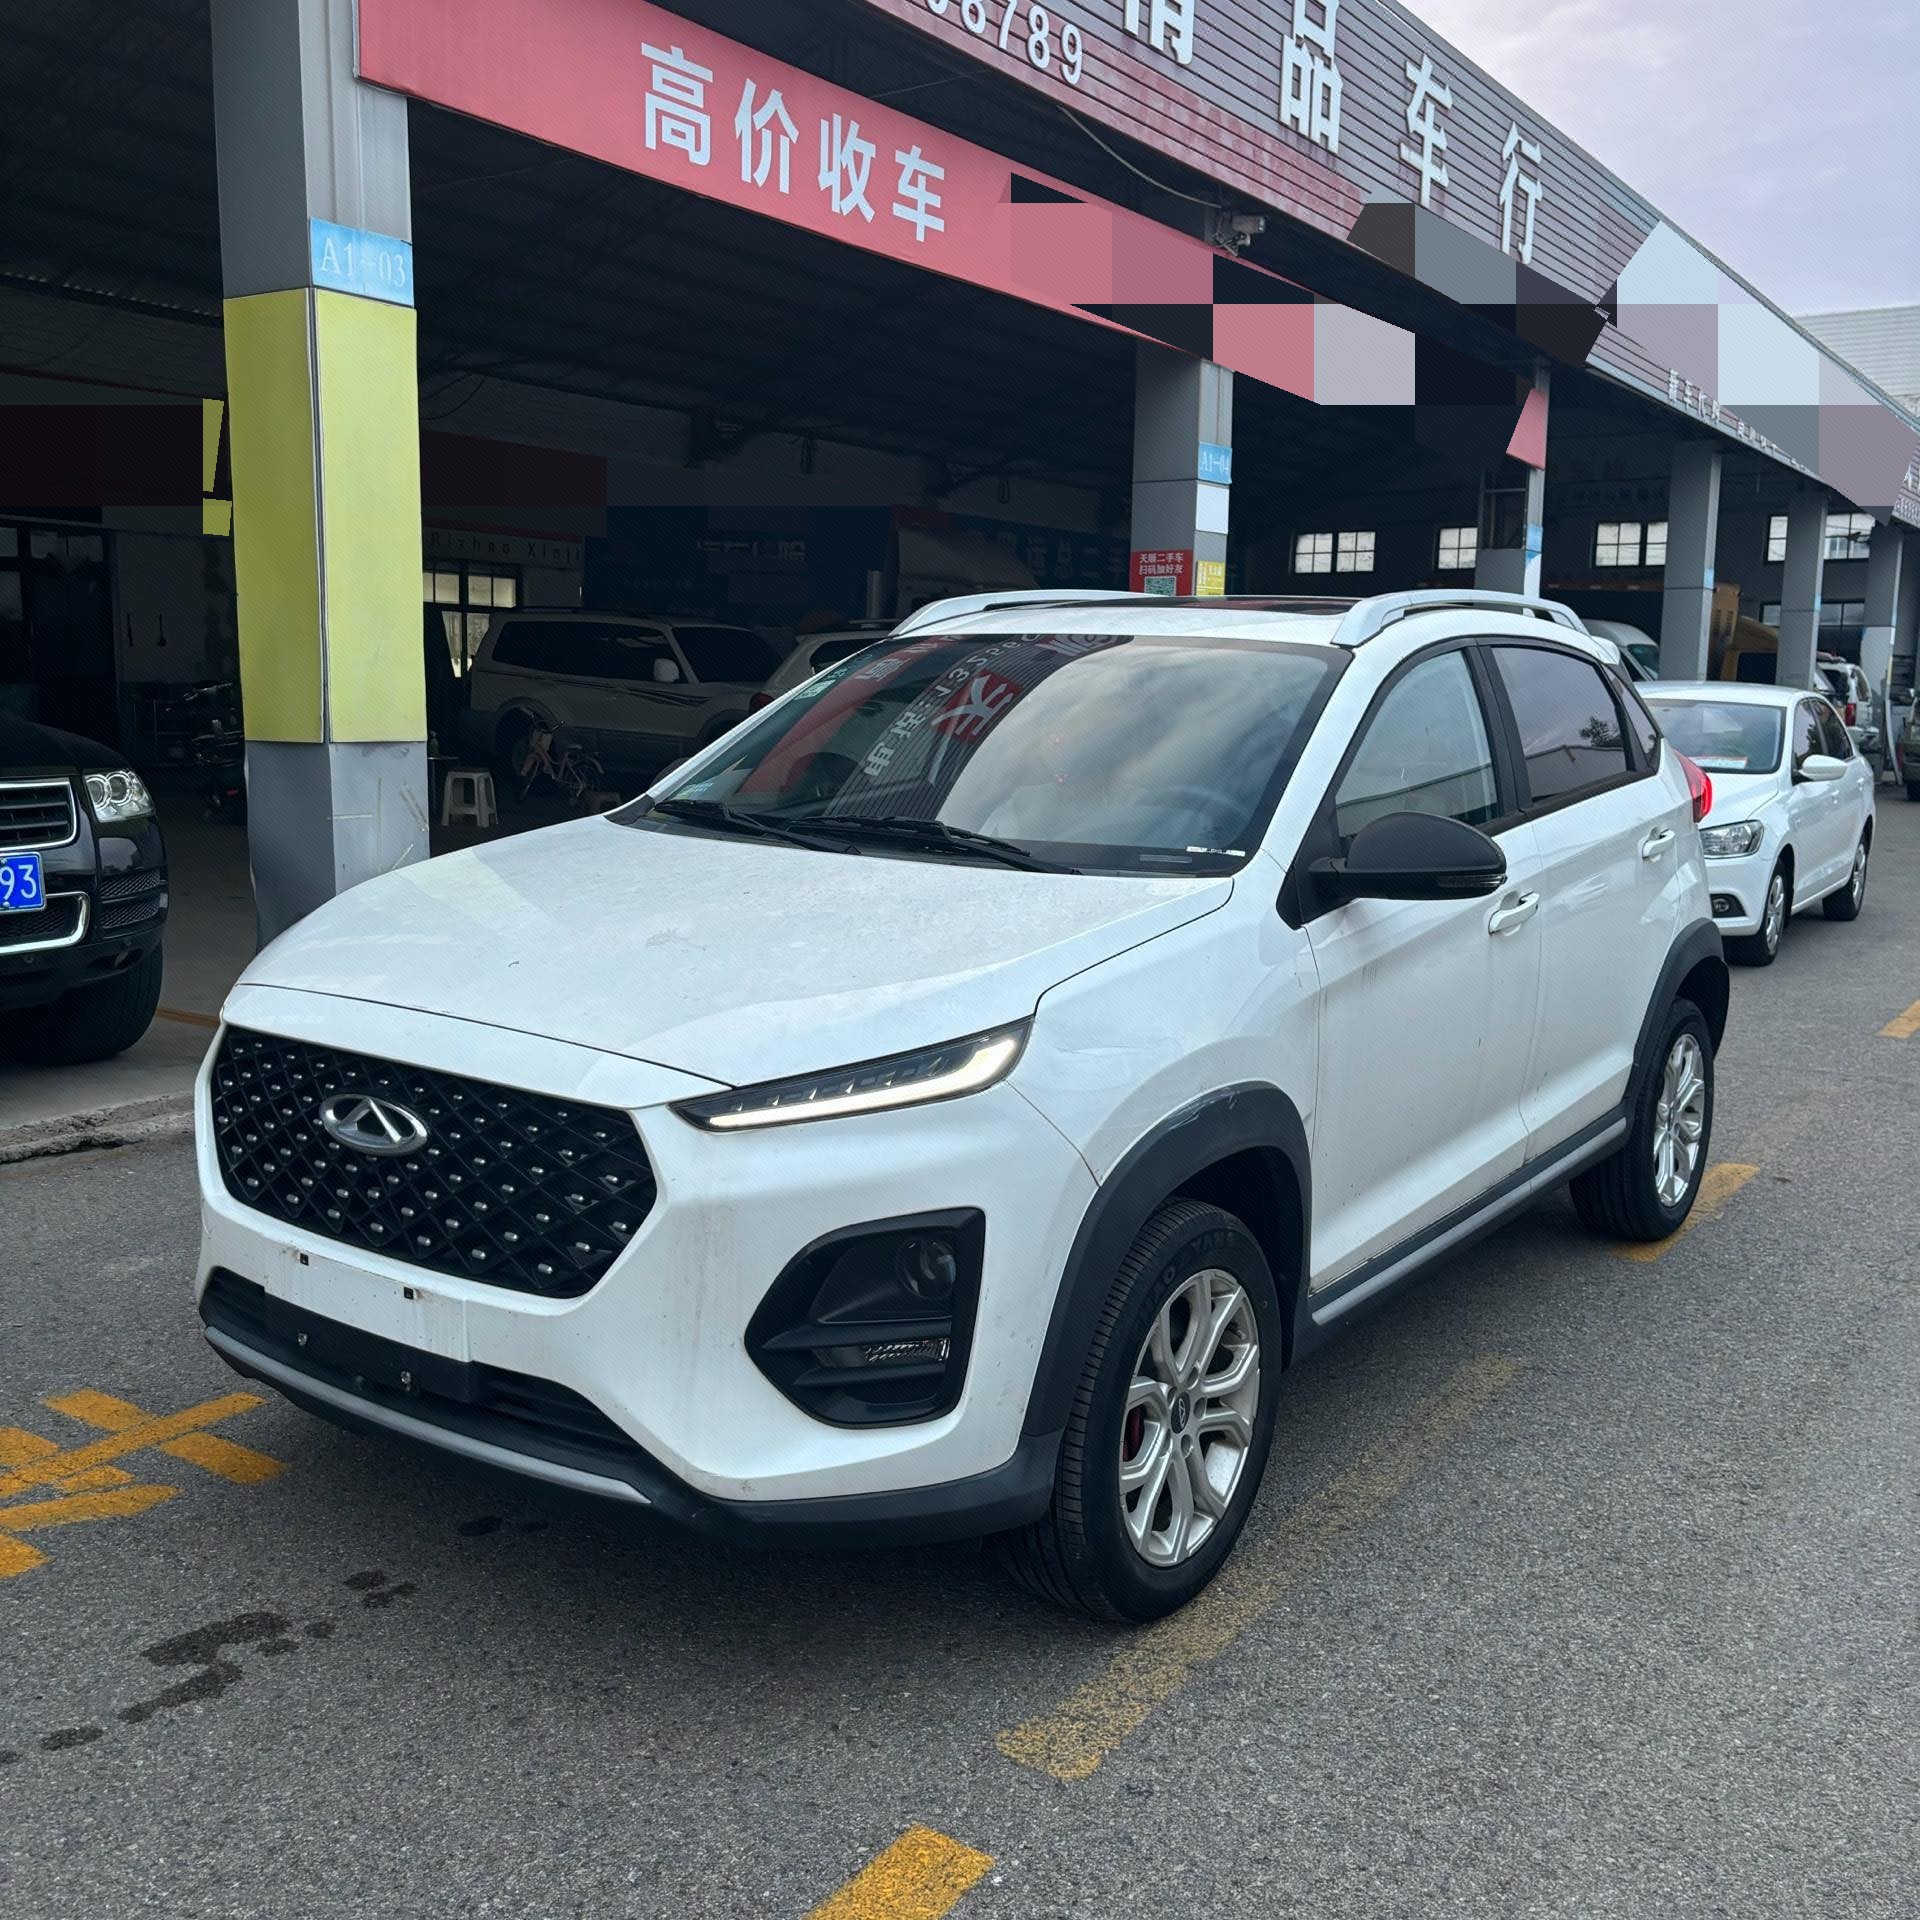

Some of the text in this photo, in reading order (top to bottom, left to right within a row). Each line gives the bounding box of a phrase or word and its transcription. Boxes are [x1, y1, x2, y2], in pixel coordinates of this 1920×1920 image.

[926, 0, 1082, 86] 6789
[641, 42, 944, 242] 高价收车
[321, 237, 405, 288] A1-03
